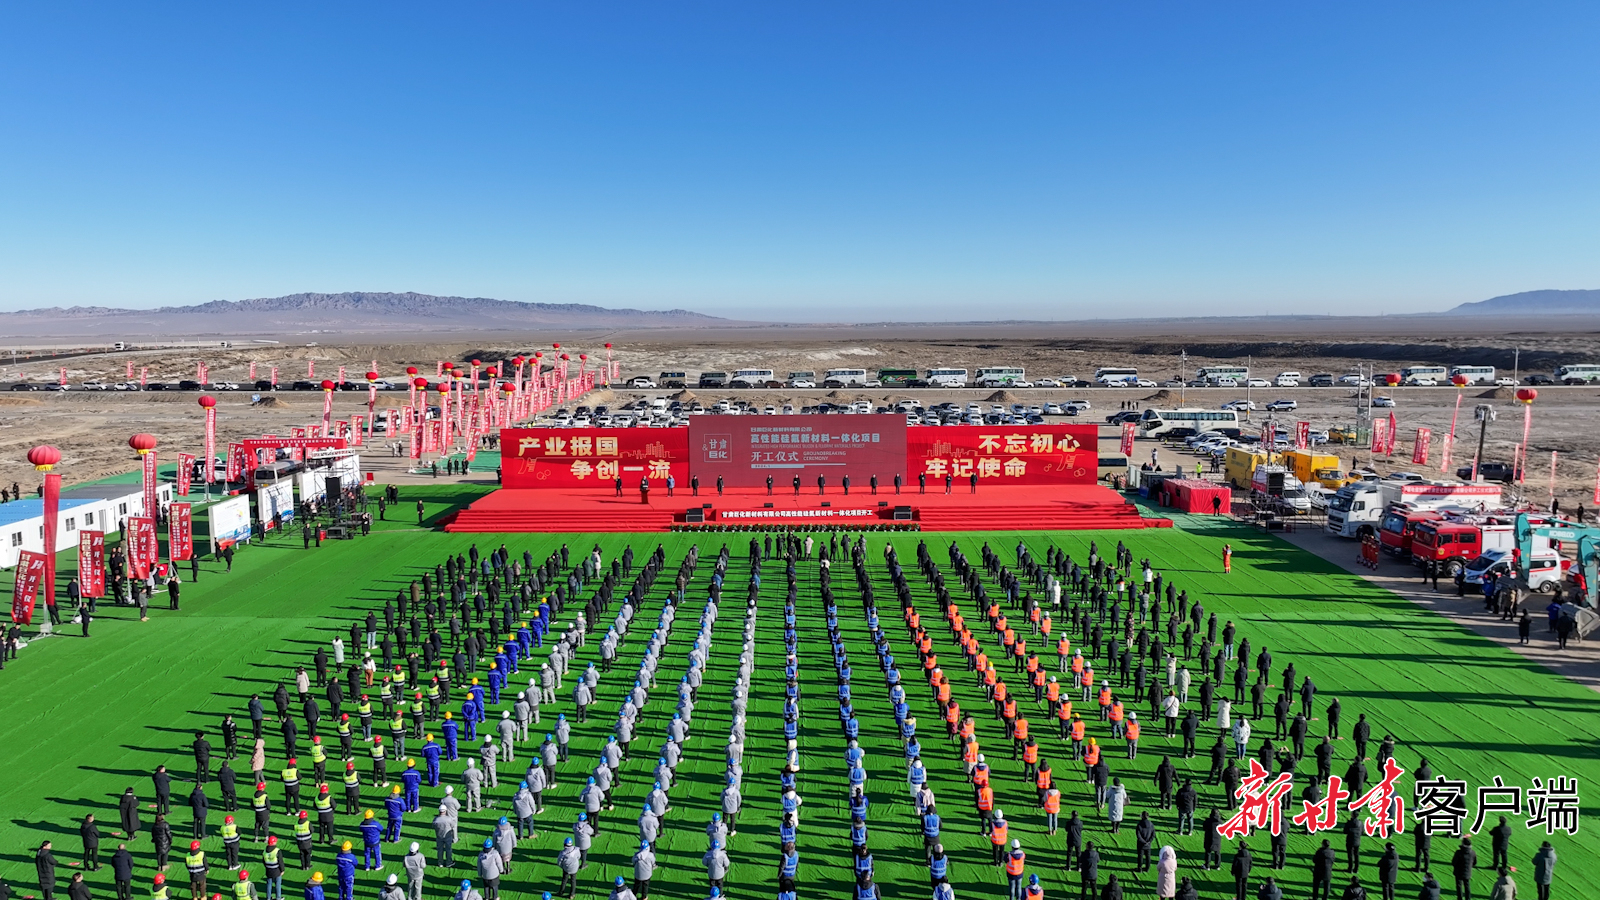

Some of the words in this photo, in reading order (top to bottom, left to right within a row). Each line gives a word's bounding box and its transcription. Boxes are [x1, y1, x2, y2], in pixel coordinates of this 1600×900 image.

[518, 436, 618, 457] 产业报国
[708, 438, 728, 450] 甘肃
[750, 433, 880, 443] 高性能硅氟新材料一体化项目
[978, 434, 1080, 454] 不忘初心
[751, 451, 799, 462] 开工仪式
[570, 460, 670, 480] 争创一流
[925, 457, 1028, 478] 牢记使命
